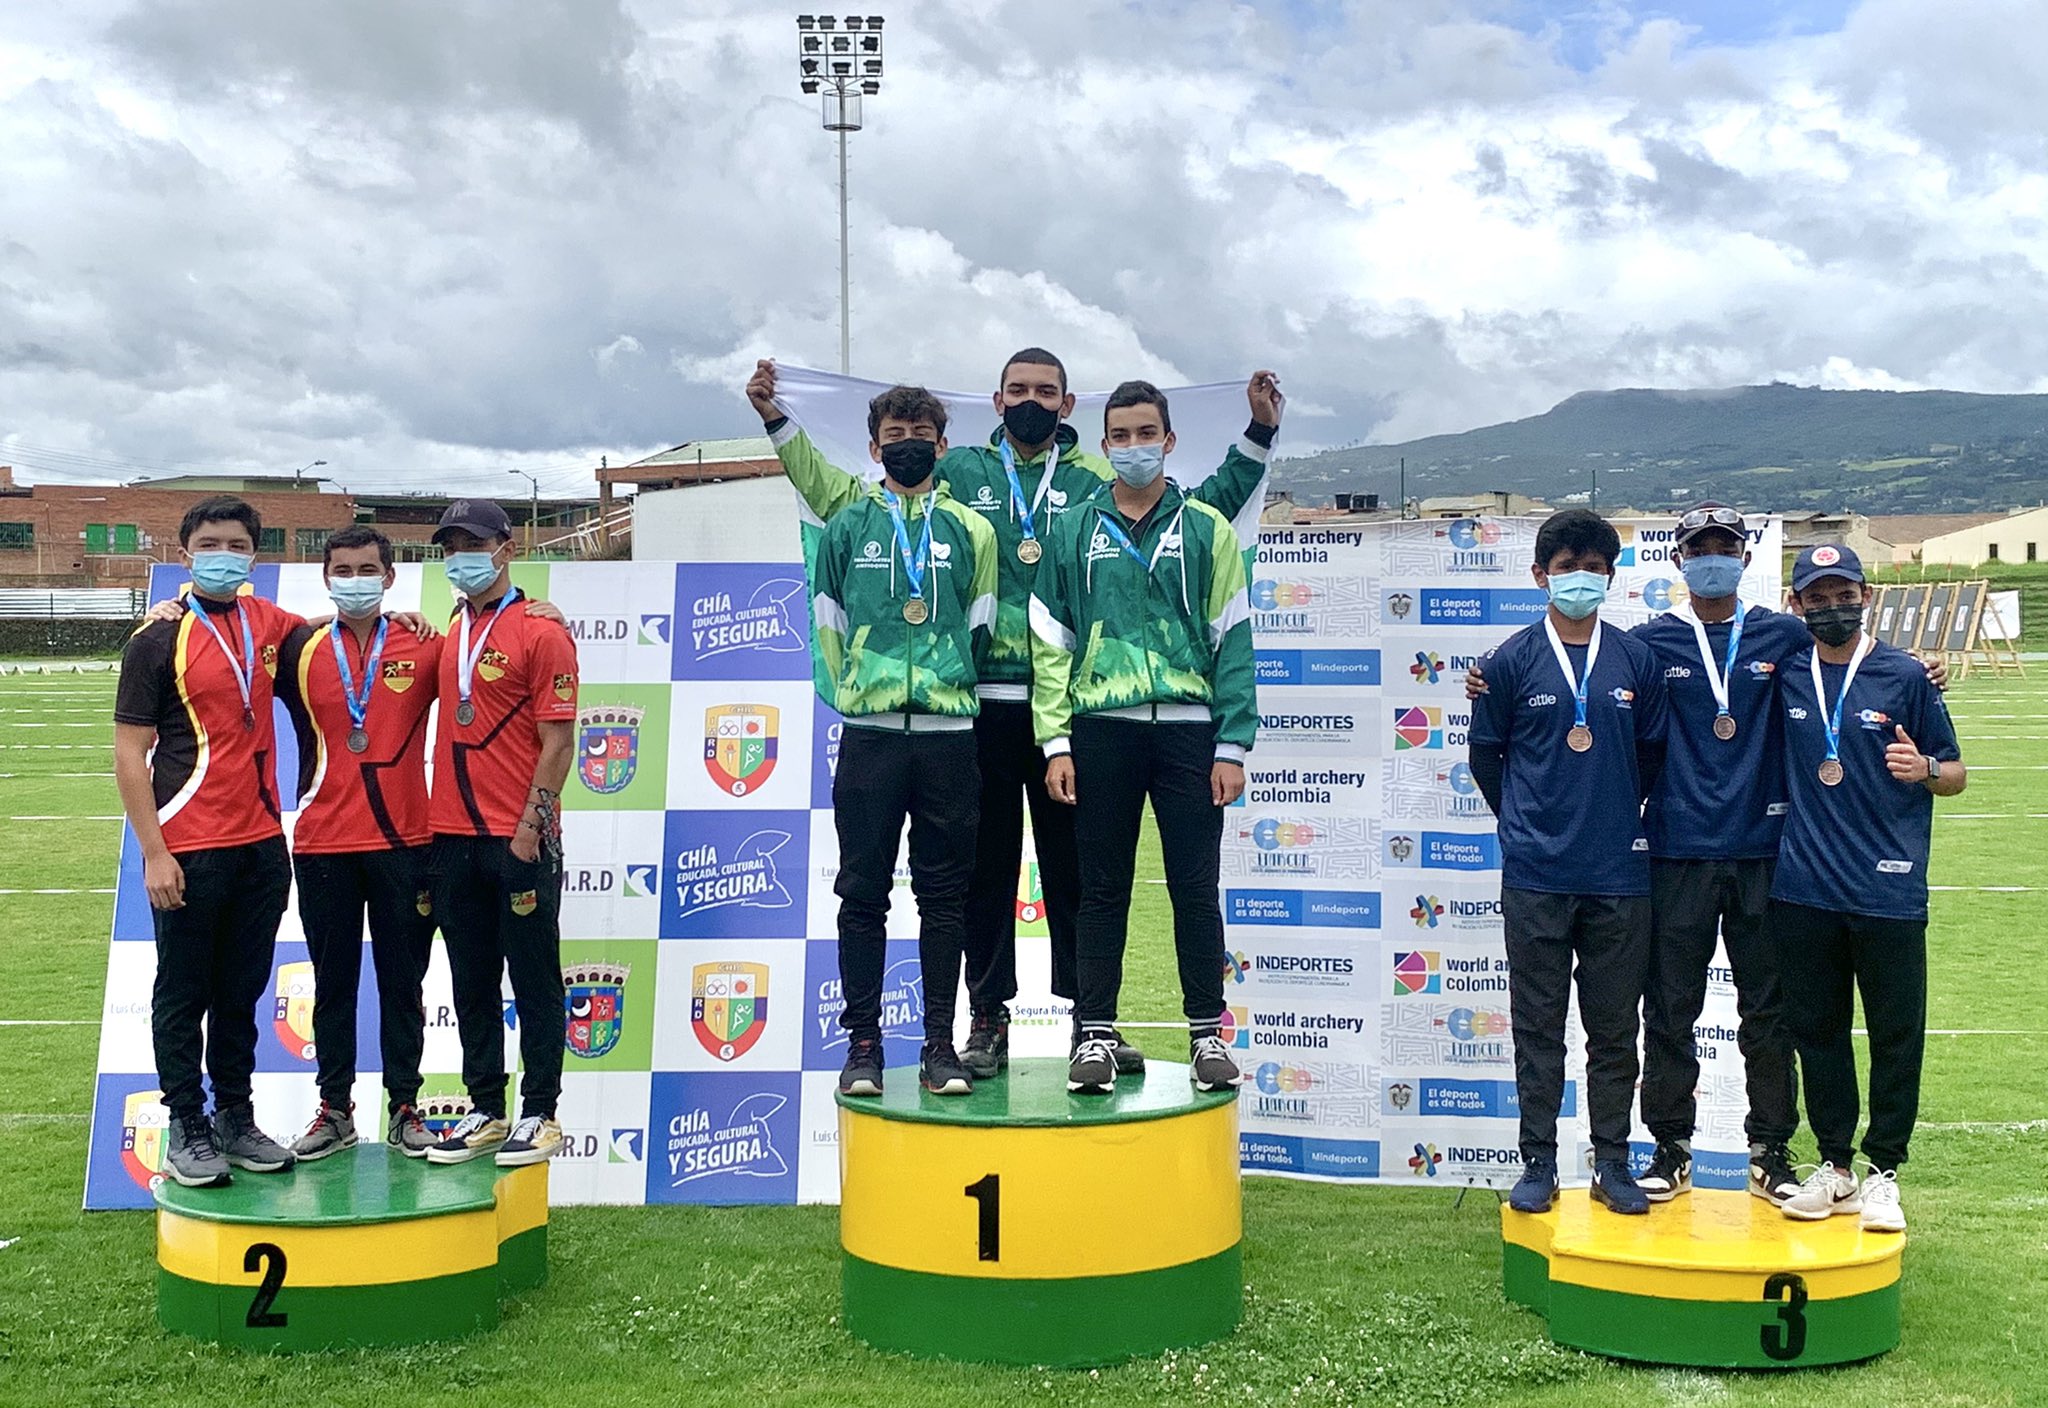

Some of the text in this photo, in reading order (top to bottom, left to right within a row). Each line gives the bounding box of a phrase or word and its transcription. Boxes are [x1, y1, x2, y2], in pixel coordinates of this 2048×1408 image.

[1258, 530, 1363, 547] orld archery
[1641, 530, 1674, 542] wor
[1258, 548, 1328, 562] olombia
[692, 592, 731, 616] CHÍA
[1430, 598, 1481, 609] El deporte
[692, 606, 778, 629] EDUCADA, CULTURAL
[1430, 609, 1481, 617] es de todo
[692, 618, 787, 650] Y SEGURA.
[1256, 660, 1284, 671] porte
[1260, 669, 1290, 678] todos
[1311, 664, 1370, 673] Mindeporte
[1257, 715, 1354, 729] NDEPORTES
[1250, 769, 1365, 788] world archery
[1250, 787, 1331, 803] colombia
[1431, 842, 1480, 853] El deporte
[677, 845, 717, 870] CHÍA
[1430, 852, 1484, 862] es de todos
[677, 858, 765, 884] EDUCADA, CULTURAL
[676, 872, 775, 907] Y SEGURA.
[1235, 898, 1285, 909] El deporte
[1311, 904, 1370, 915] Mindeporte
[1450, 900, 1504, 915] INDEPO
[1235, 908, 1290, 918] es de todos
[1256, 955, 1353, 973] INDEPORTES
[1446, 956, 1489, 972] world
[819, 979, 842, 1000] CH
[1446, 975, 1507, 992] colomb
[818, 1000, 847, 1015] EDUCA
[1015, 1005, 1049, 1017] Segura
[818, 1016, 832, 1038] Y
[1254, 1011, 1364, 1033] world archery
[1254, 1030, 1328, 1048] colombia
[1694, 1025, 1737, 1041] arche
[1428, 1089, 1480, 1100] El deporte
[1441, 1099, 1455, 1107] de
[1457, 1100, 1486, 1109] todos
[669, 1109, 711, 1136] CHÍA
[668, 1123, 759, 1150] EDUCADA, CULTURAL
[813, 1130, 832, 1142] Luis
[1250, 1142, 1287, 1154] deporte
[1448, 1147, 1520, 1164] INDEPOR
[668, 1138, 769, 1175] Y SEGURA.
[1252, 1152, 1265, 1161] de
[1267, 1153, 1293, 1164] todos
[1311, 1152, 1369, 1164] Mindeporte
[1697, 1165, 1749, 1177] Mindeport
[965, 1173, 1000, 1263] 1
[243, 1242, 288, 1328] 2
[1760, 1272, 1808, 1361] 3
